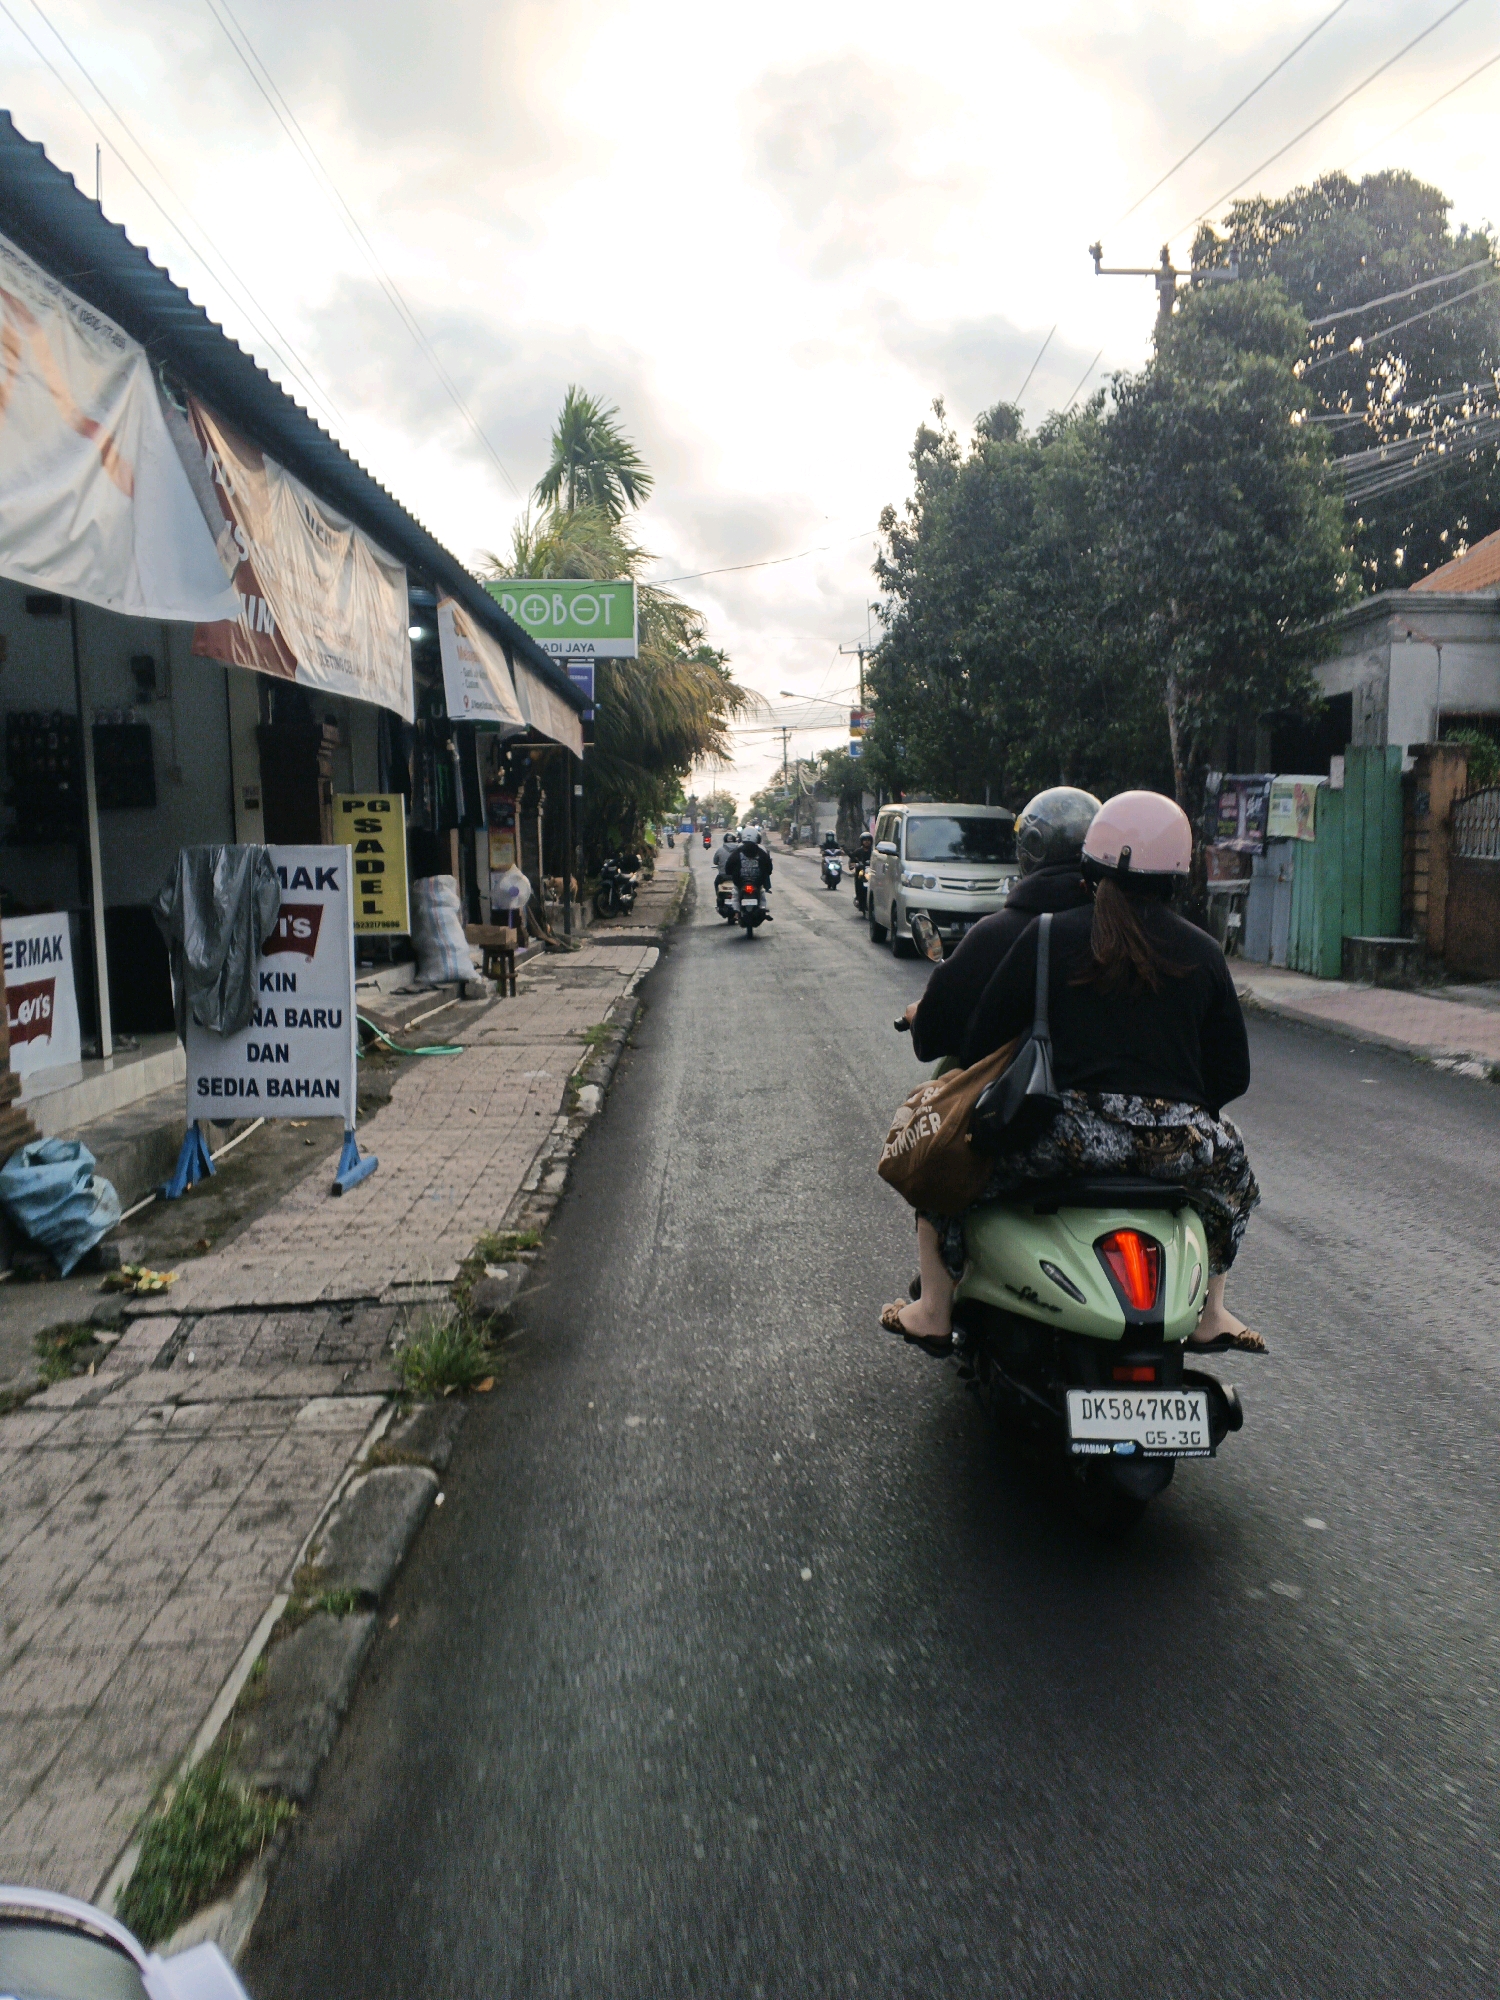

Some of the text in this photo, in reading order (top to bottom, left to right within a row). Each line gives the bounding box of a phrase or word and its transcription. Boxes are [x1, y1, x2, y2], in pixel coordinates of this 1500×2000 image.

[565, 642, 596, 653] JAYA
[342, 799, 391, 813] PG
[353, 818, 386, 915] SADEL
[259, 972, 297, 993] KIN
[284, 1008, 342, 1029] BARU
[247, 1043, 289, 1063] DAN
[197, 1077, 340, 1098] SEDIA BAHAN
[1082, 1398, 1201, 1422] DK5847KBX
